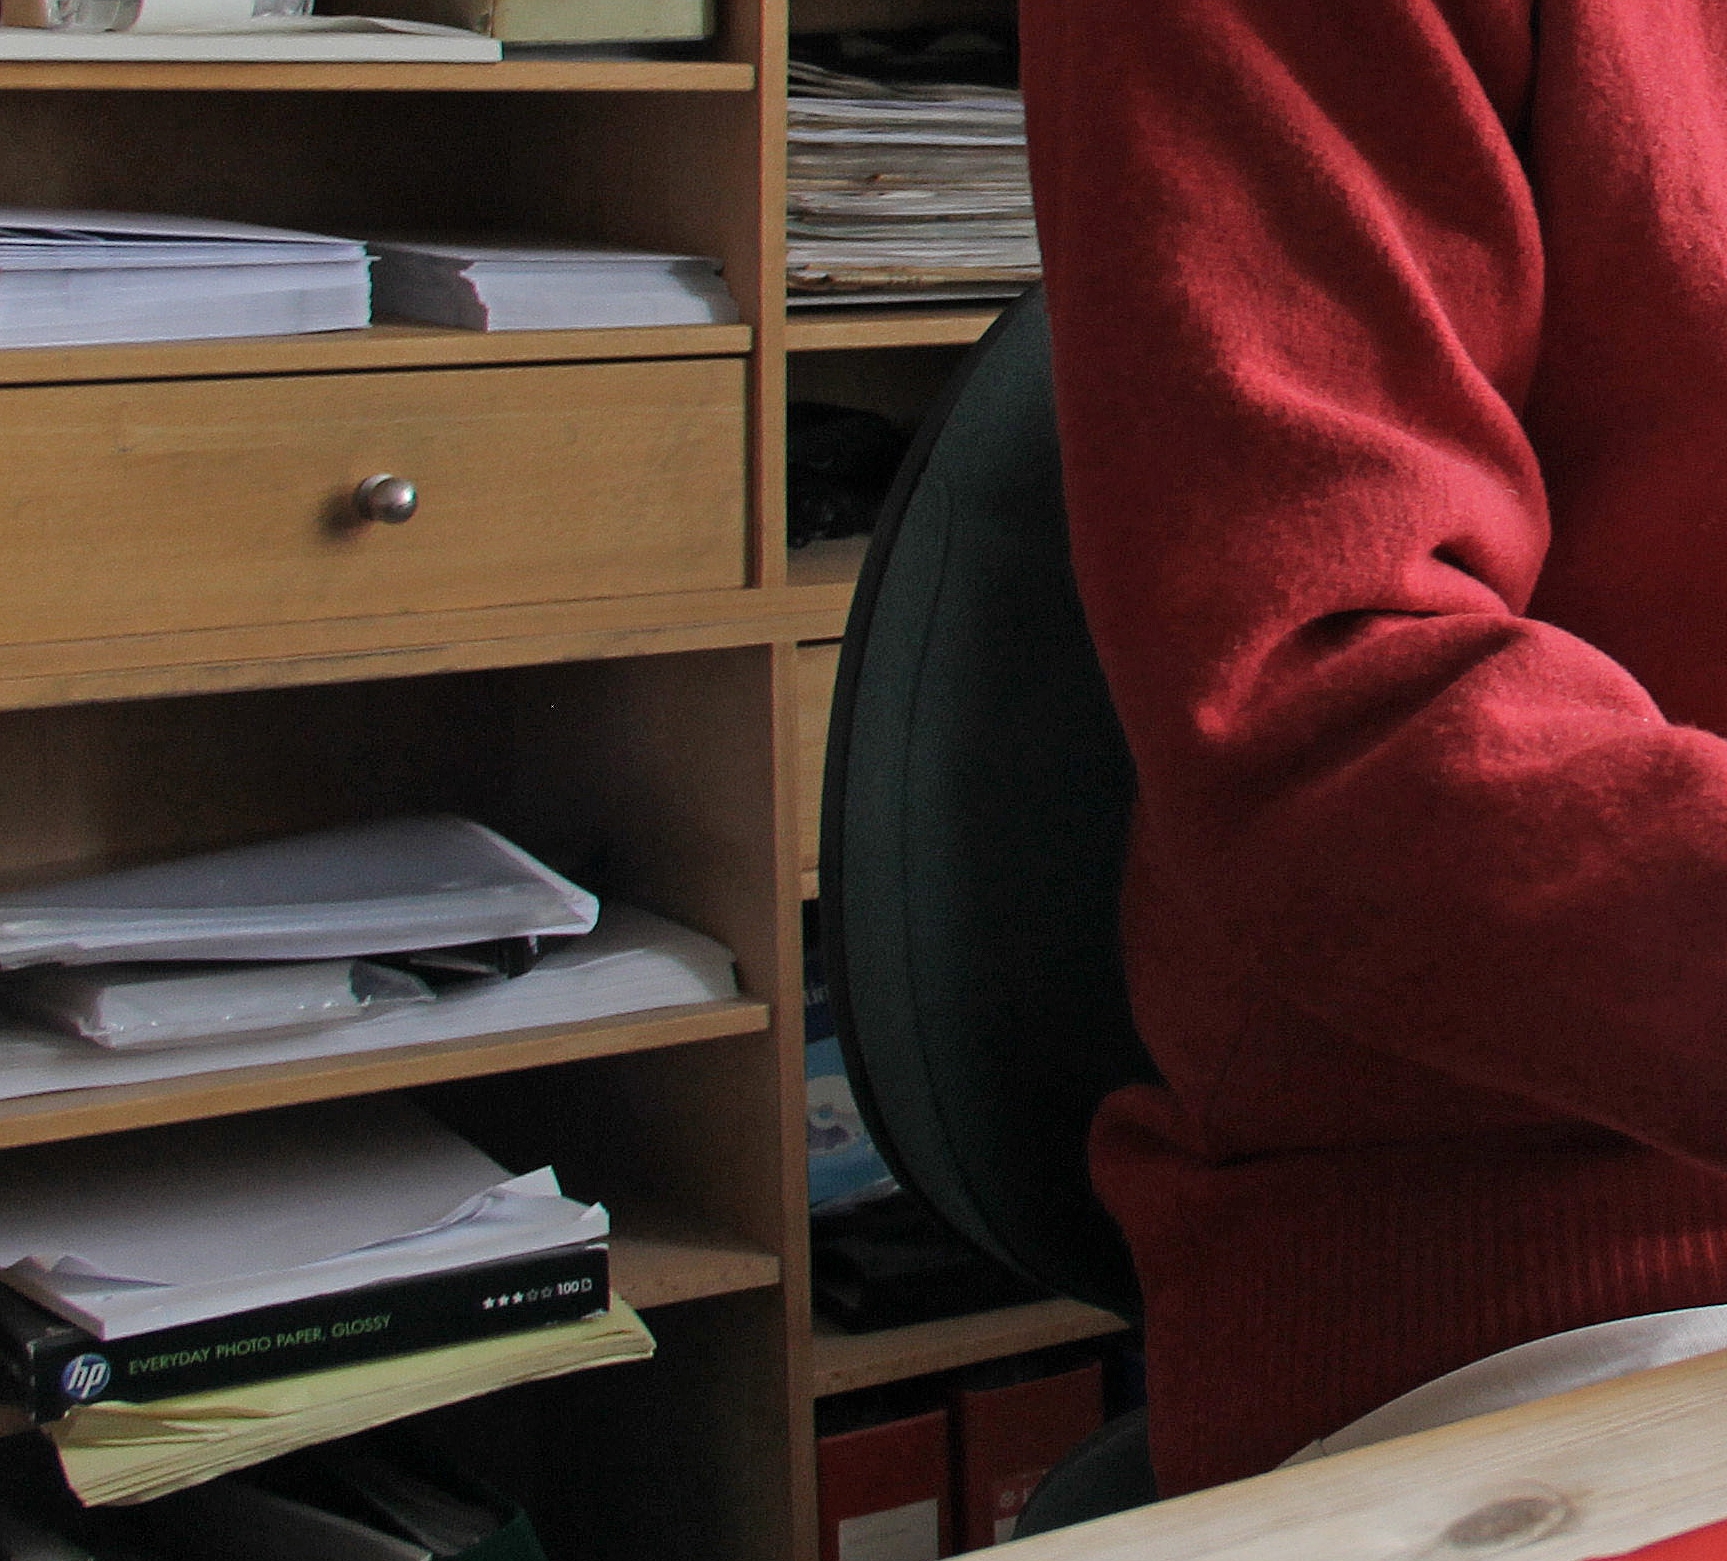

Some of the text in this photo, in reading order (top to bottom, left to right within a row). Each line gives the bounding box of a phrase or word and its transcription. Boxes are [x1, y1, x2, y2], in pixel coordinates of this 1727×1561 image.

[129, 1279, 580, 1376] EVERYDAY PHOTO PAPER, GLOSSY 100
[67, 1357, 107, 1400] hp
